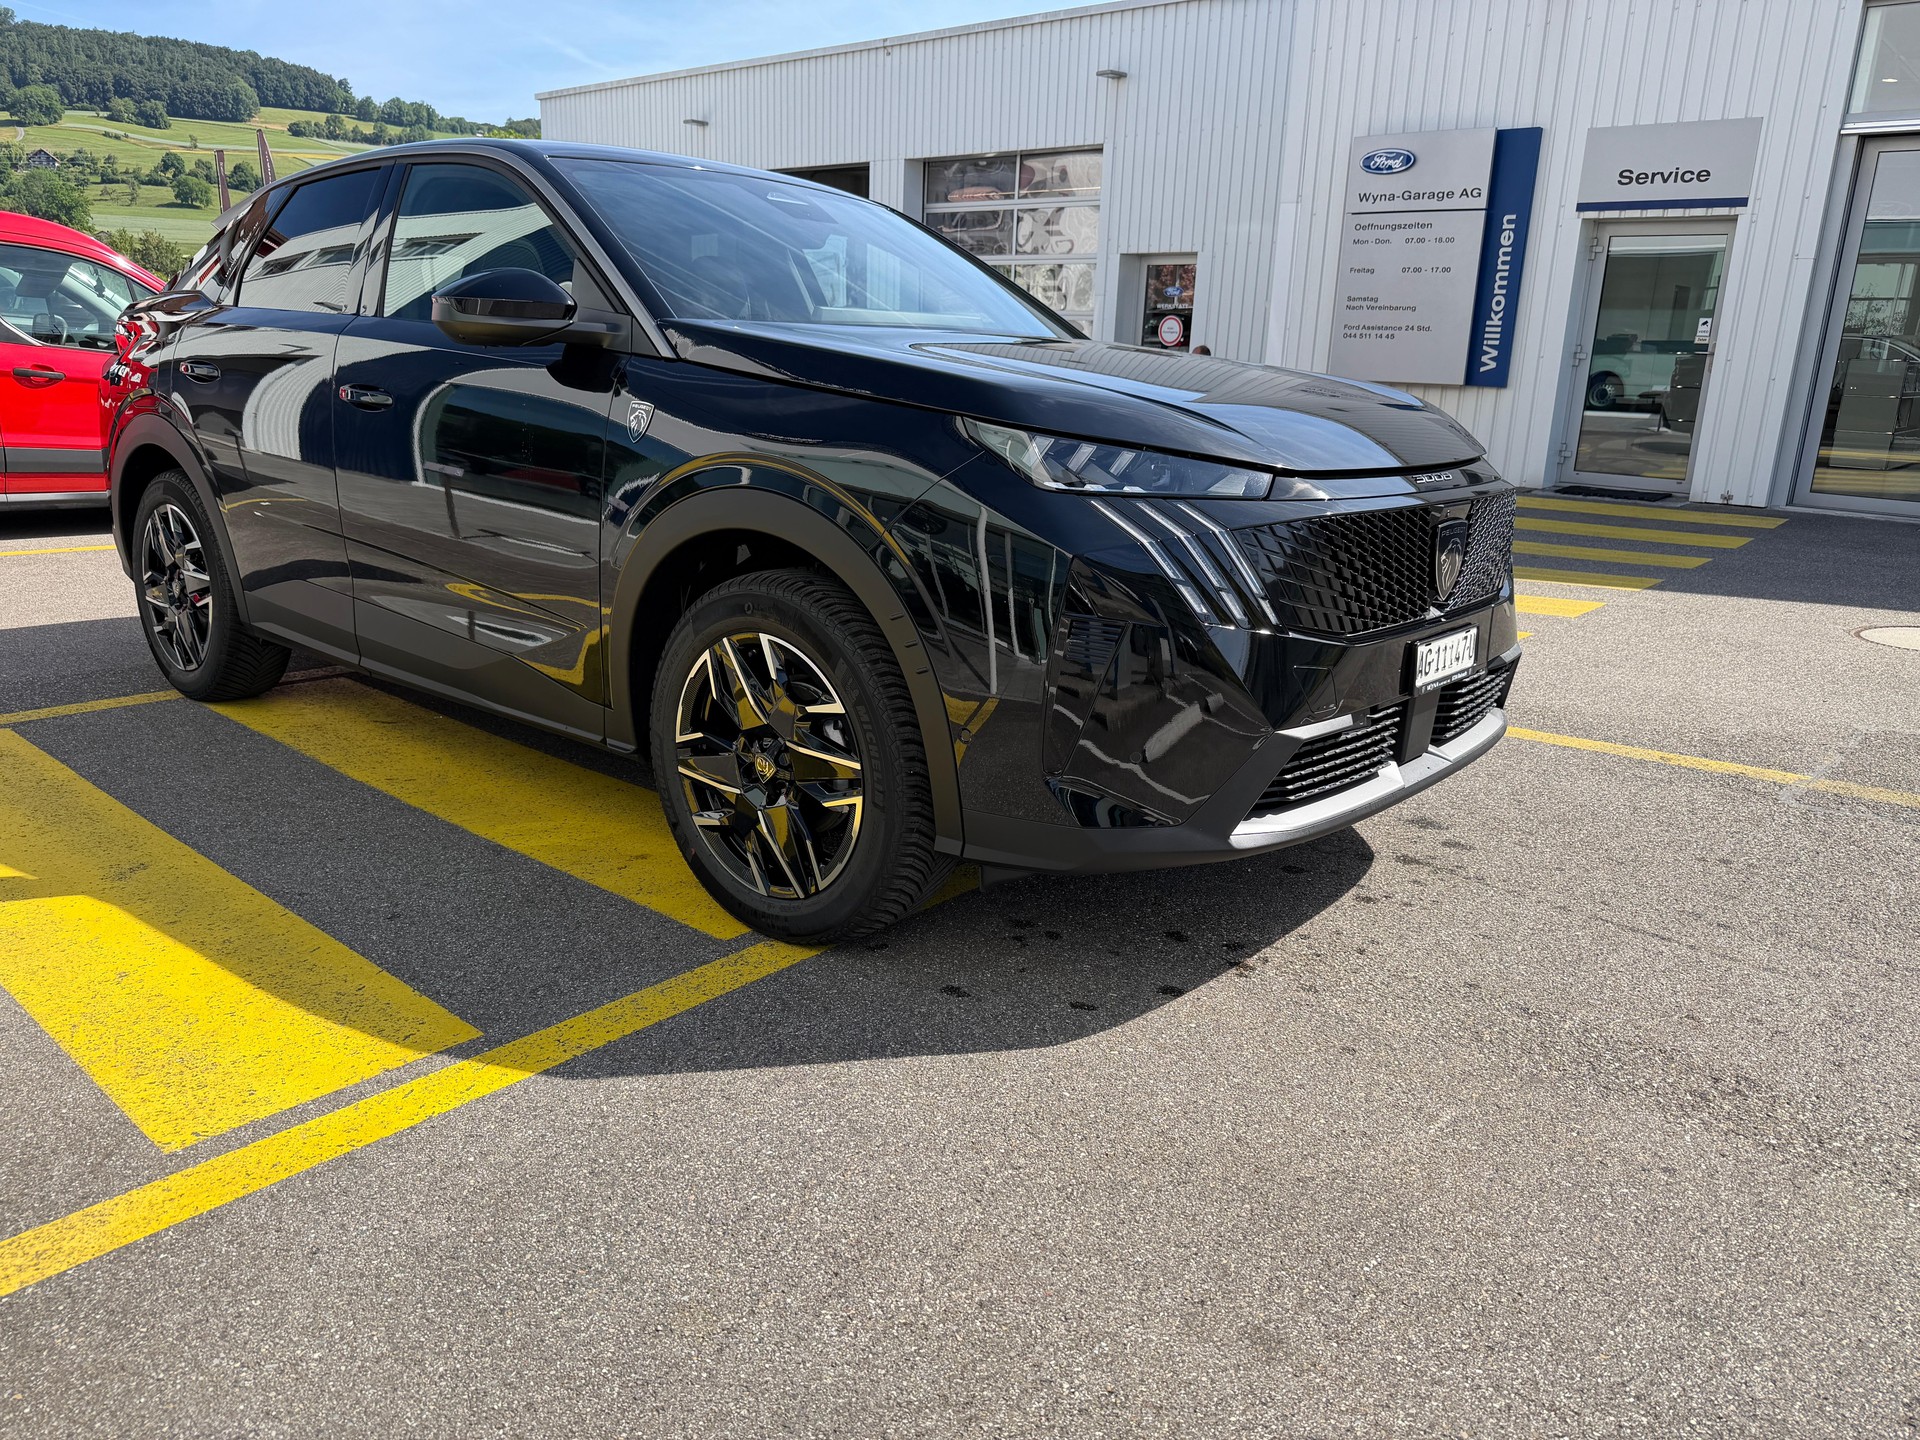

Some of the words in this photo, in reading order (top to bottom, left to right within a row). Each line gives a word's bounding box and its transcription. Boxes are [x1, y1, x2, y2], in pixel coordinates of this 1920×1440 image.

[1617, 167, 1711, 186] Service
[1358, 189, 1455, 205] Wyna-Garage
[1459, 187, 1482, 199] AG
[1354, 221, 1433, 232] Oeffnungszeiten
[1434, 236, 1455, 244] 18.00
[1349, 267, 1375, 275] Freitag
[1480, 214, 1517, 372] Willkommen
[1346, 295, 1379, 303] Samstag
[1365, 304, 1417, 312] Vereinbarung
[632, 403, 652, 411] PEUGEOT
[1441, 526, 1466, 537] PEUGEOT
[855, 705, 886, 808] MICHELIN
